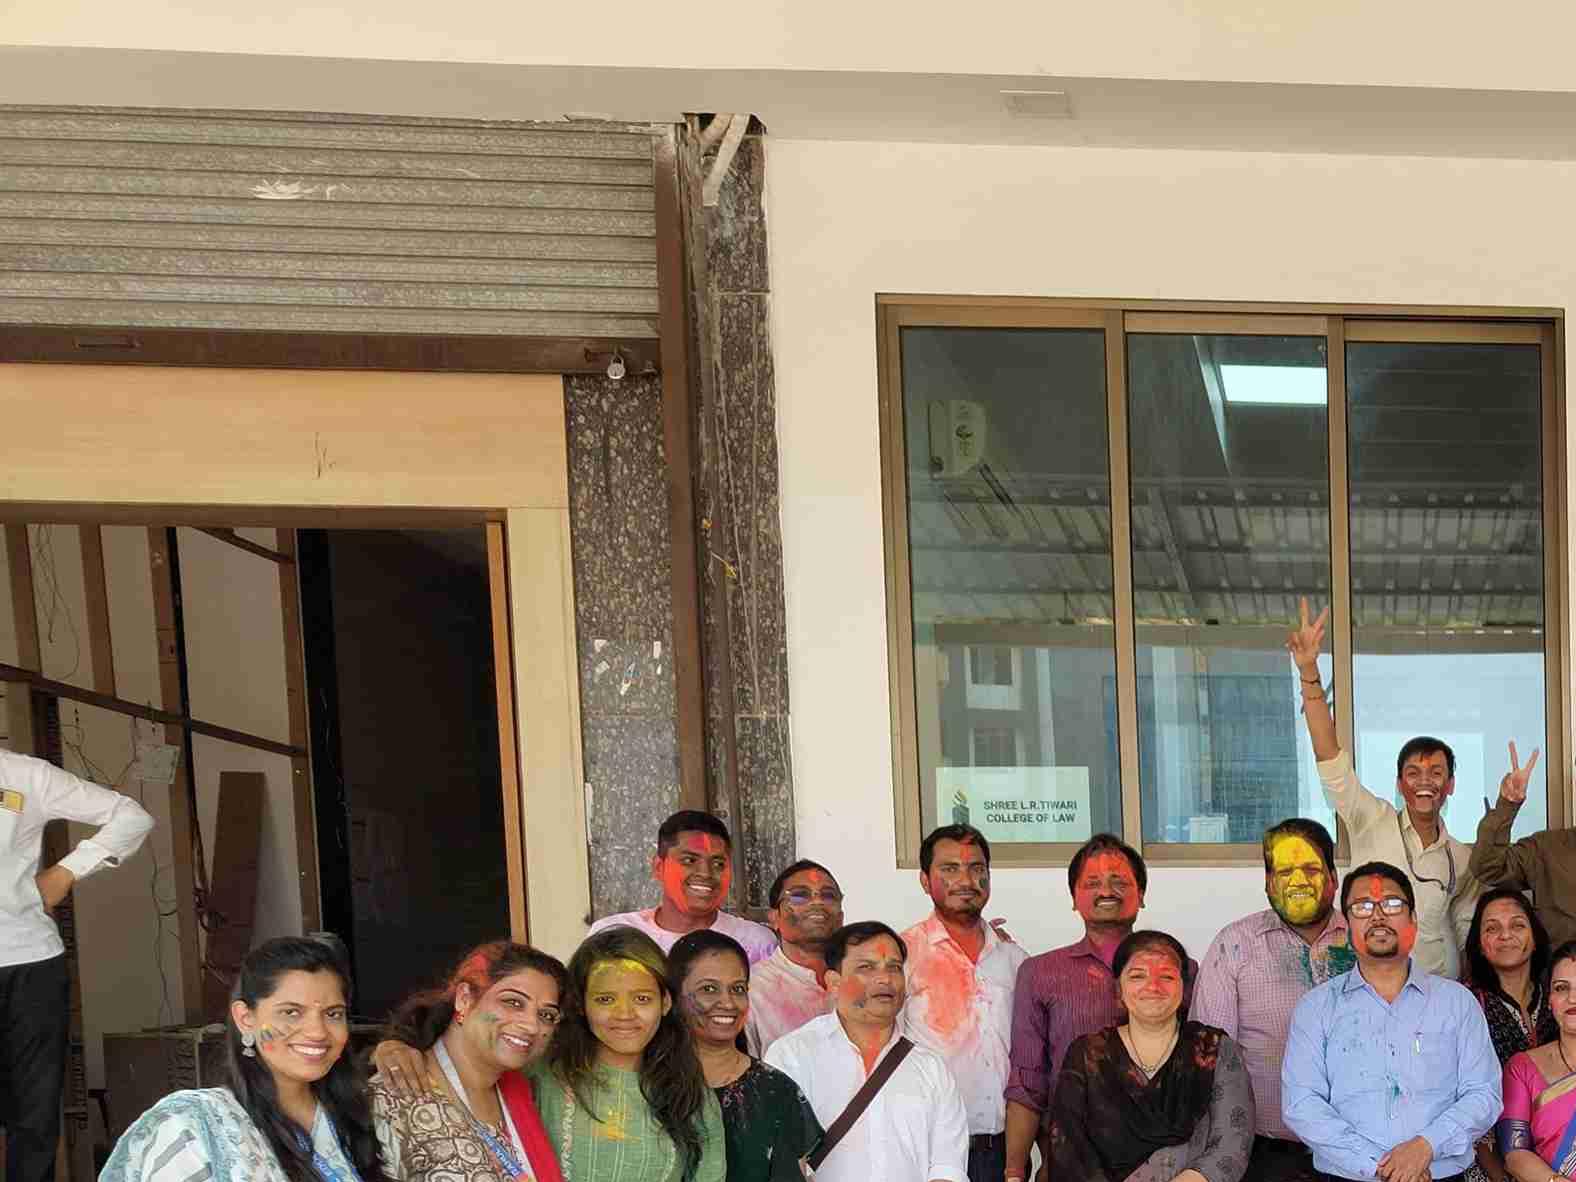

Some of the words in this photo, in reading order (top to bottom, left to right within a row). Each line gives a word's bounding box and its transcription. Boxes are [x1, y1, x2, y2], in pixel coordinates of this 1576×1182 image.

[983, 800, 1018, 810] SHREE
[986, 813, 1033, 823] COLLEGE
[1035, 813, 1049, 823] OF
[1052, 813, 1076, 823] LAW
